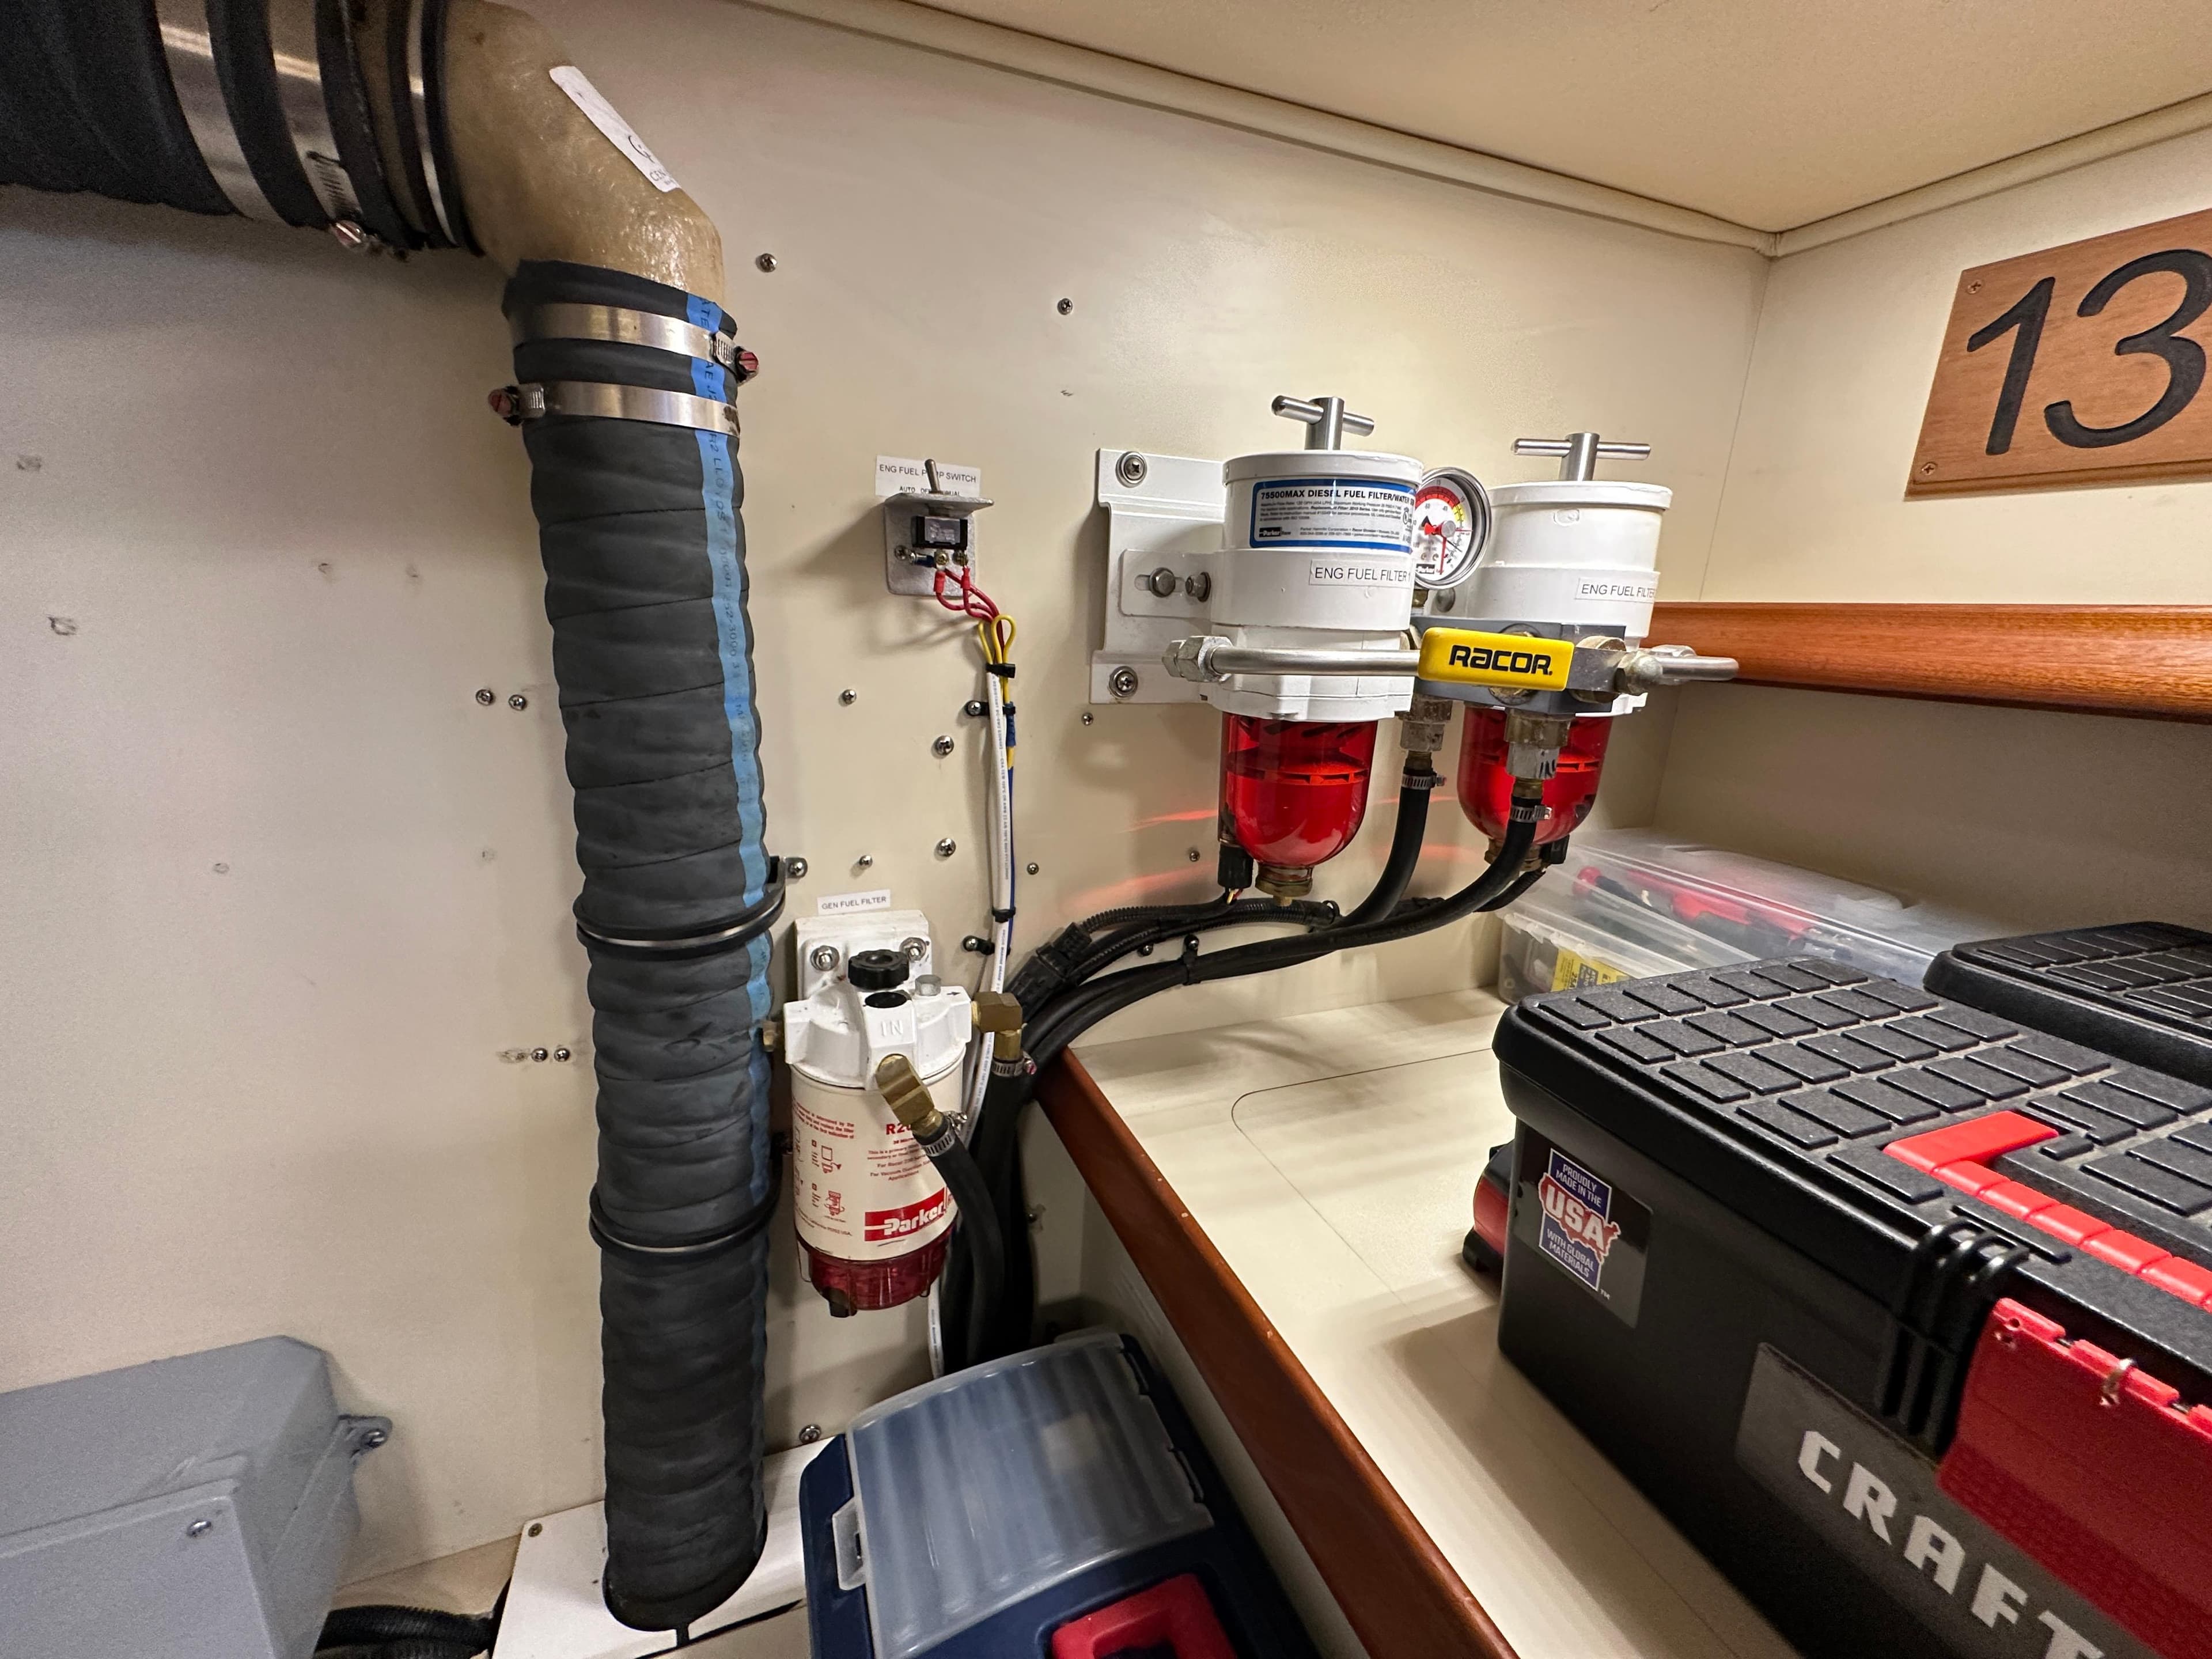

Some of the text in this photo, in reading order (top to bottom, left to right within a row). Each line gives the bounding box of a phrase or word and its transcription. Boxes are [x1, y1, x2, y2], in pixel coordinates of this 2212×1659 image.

[1967, 249, 2212, 455] 13
[879, 464, 976, 483] ENG FUEL PP SWITCH
[899, 486, 916, 494] AUTO
[1344, 490, 1366, 498] FUEL
[1368, 491, 1410, 503] FILTER/WATER
[1315, 567, 1343, 579] ENG
[1347, 568, 1377, 581] FUEL
[1380, 569, 1407, 582] FILTER
[1581, 584, 1608, 595] ENG
[1610, 585, 1635, 597] FUEL
[821, 896, 887, 910] GEN FUEL FILTER
[881, 1020, 904, 1036] IN
[886, 1123, 912, 1135] R2
[1556, 1169, 1602, 1208] MADE IN THE
[1563, 1164, 1597, 1192] PROUDLY
[884, 1201, 945, 1236] Parker
[1546, 1184, 1604, 1251] USA
[1547, 1228, 1595, 1272] WITH GLOBAL
[1550, 1241, 1590, 1279] MATERIALS
[1798, 1430, 2105, 1659] CRAFT
